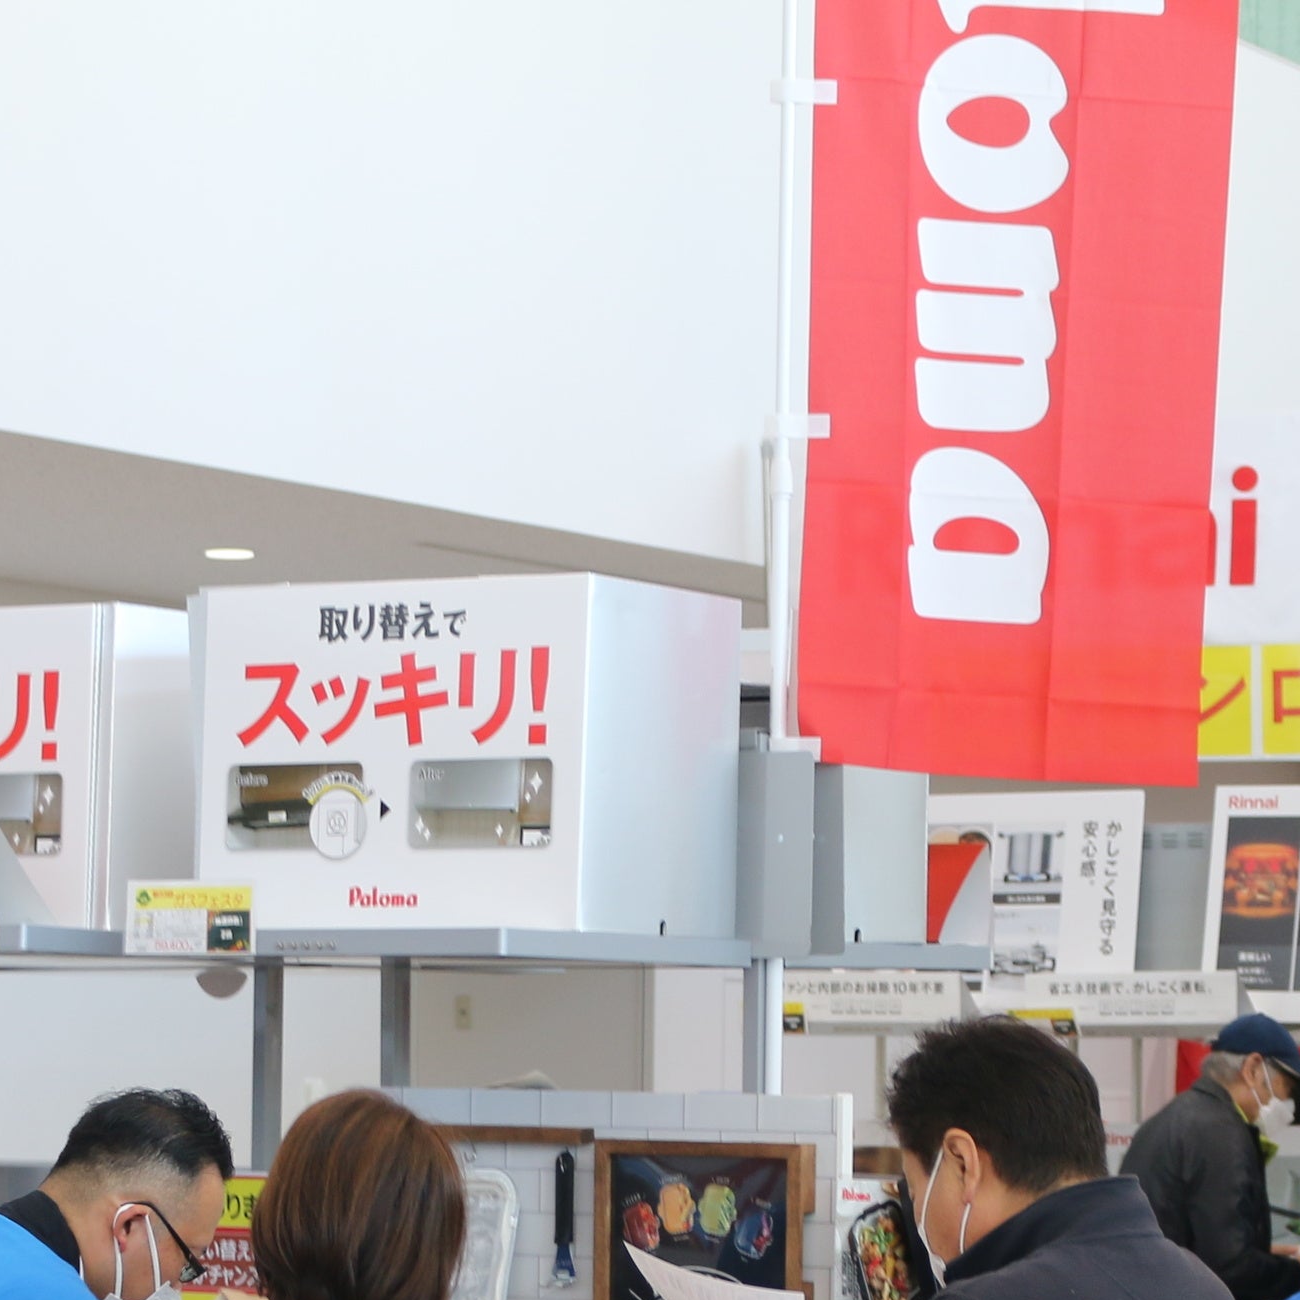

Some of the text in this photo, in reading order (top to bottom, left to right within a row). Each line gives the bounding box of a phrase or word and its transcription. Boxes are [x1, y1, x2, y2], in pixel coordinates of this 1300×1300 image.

[317, 601, 468, 645] 取り替えで
[236, 645, 552, 748] スッキリ!
[1227, 795, 1279, 810] Rinnai
[349, 885, 419, 909] Paloma
[1100, 819, 1122, 957] かしこく見守る
